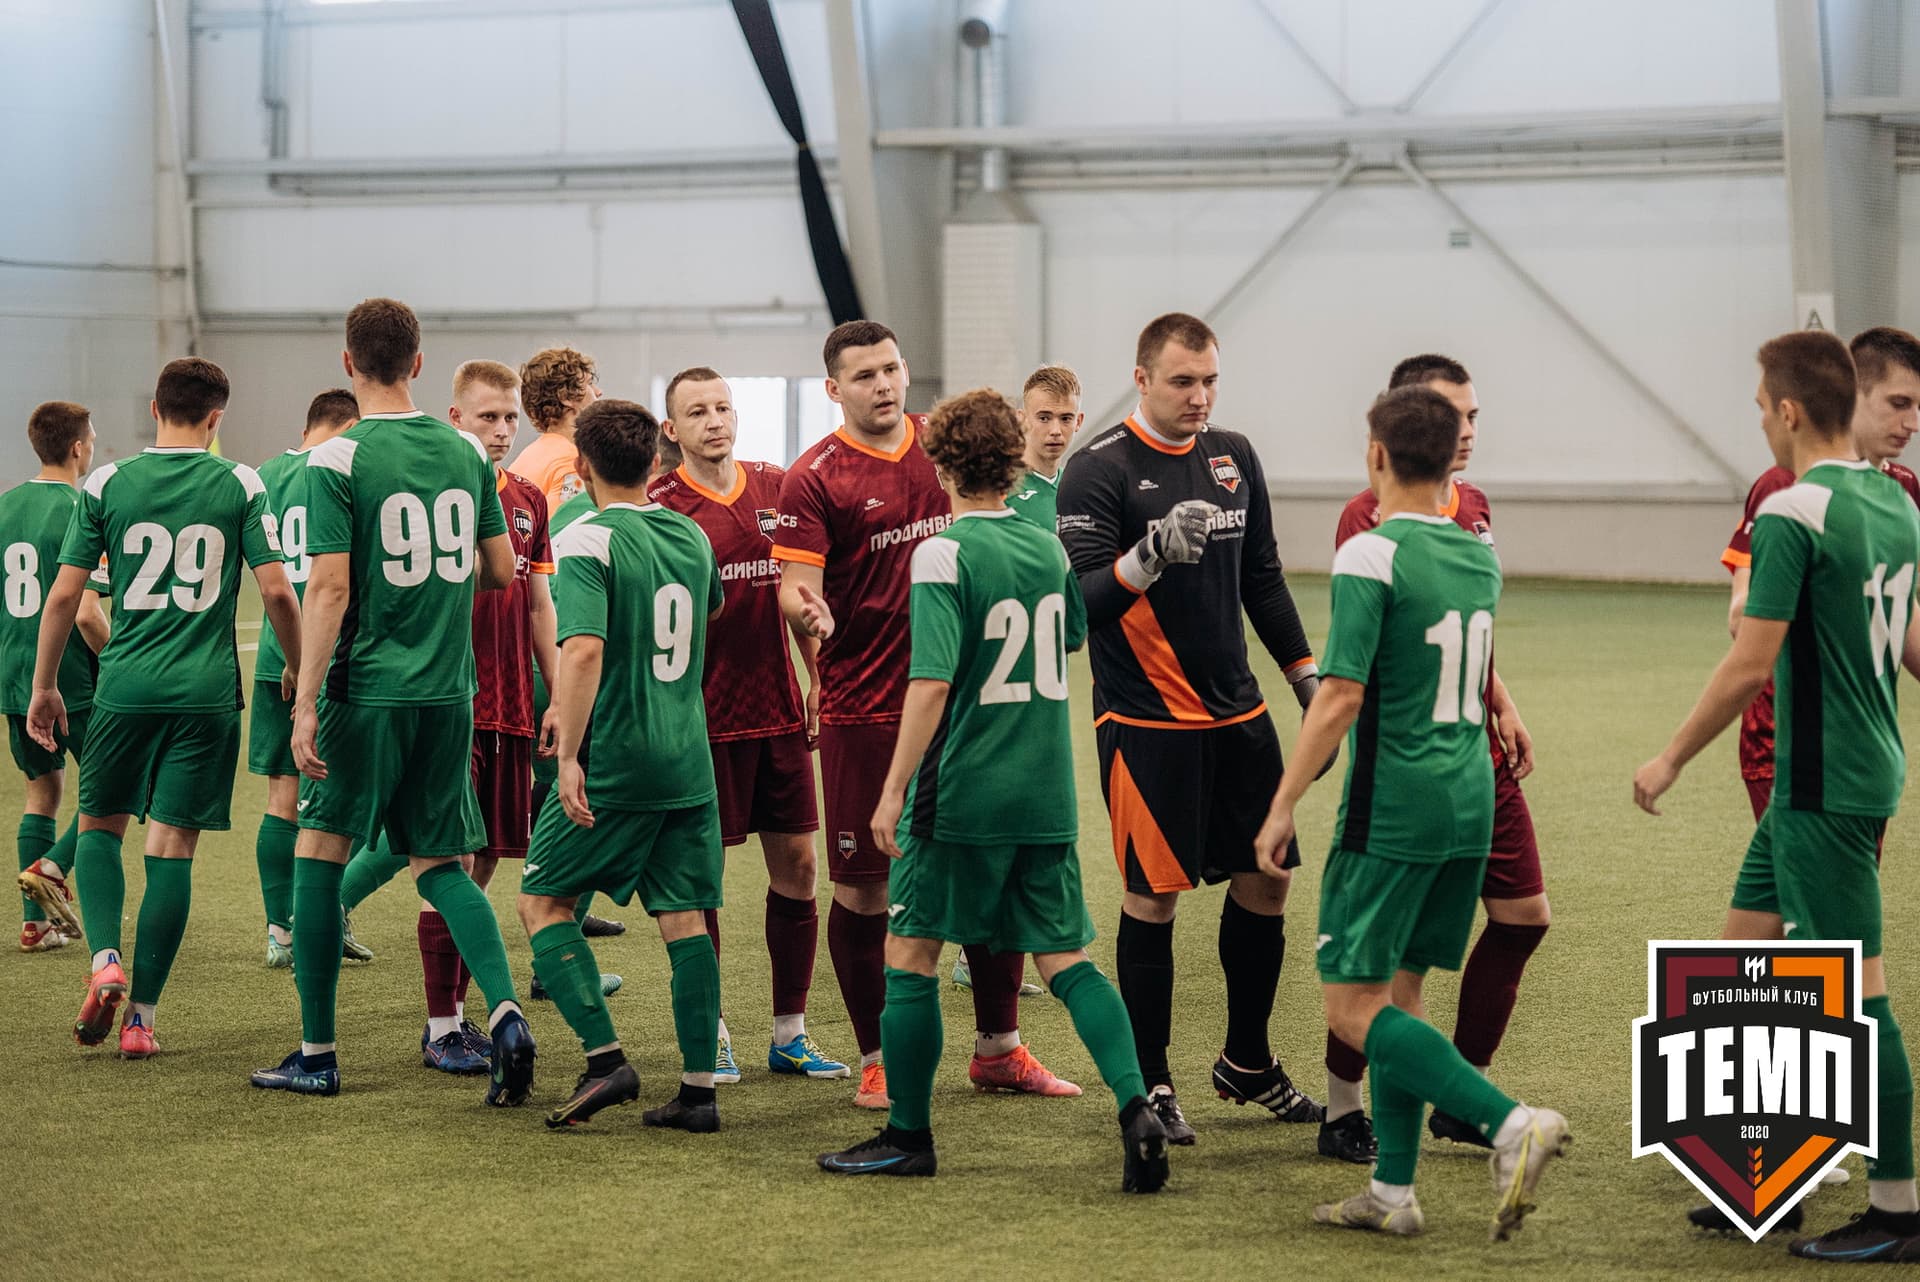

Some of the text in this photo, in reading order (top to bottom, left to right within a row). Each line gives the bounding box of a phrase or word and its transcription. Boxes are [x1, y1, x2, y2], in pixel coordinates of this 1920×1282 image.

[4, 542, 41, 618] 8
[123, 522, 226, 612] 29
[380, 488, 475, 587] 99
[652, 583, 693, 682] 9
[979, 592, 1069, 706] 20
[1425, 609, 1493, 725] 10
[1863, 562, 1916, 679] 11
